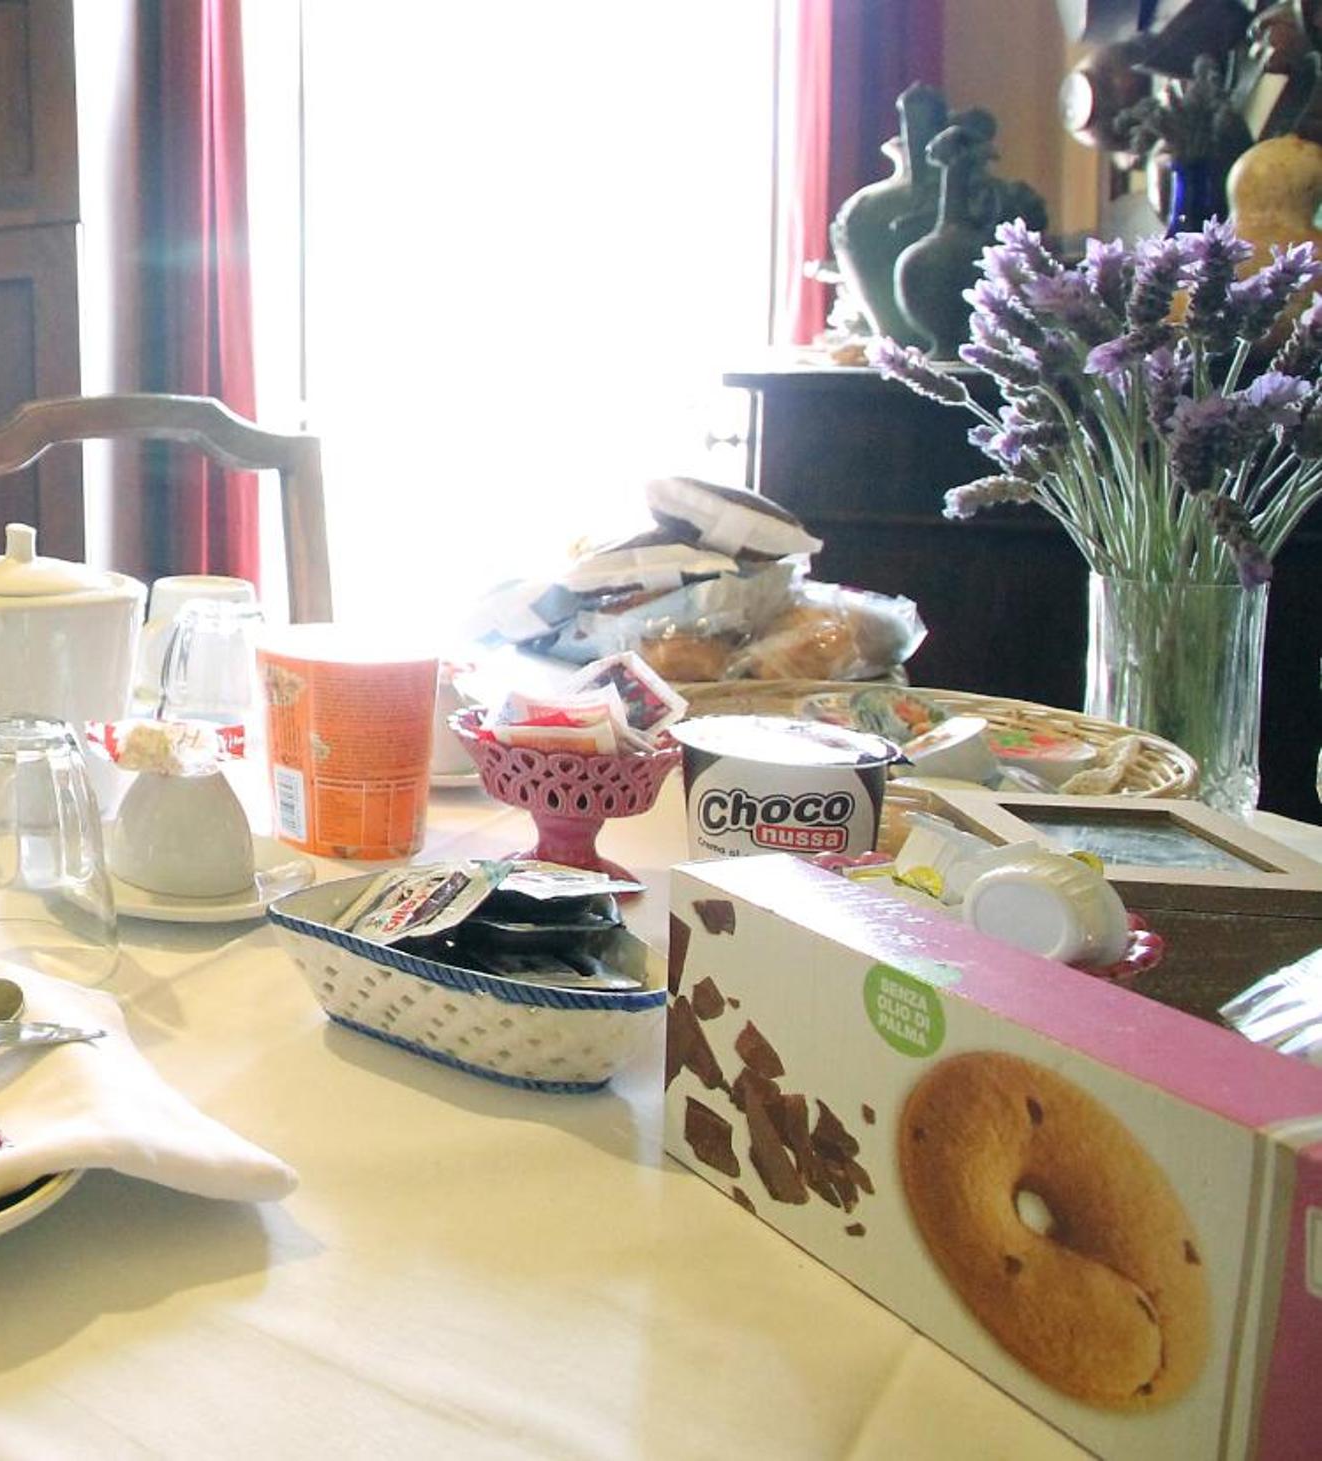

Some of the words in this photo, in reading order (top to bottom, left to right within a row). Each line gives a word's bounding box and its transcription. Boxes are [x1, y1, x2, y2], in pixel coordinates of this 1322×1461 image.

[700, 791, 852, 832] Choco
[697, 836, 726, 854] Crema
[761, 826, 839, 847] nussa
[880, 977, 928, 1012] SENZA
[877, 994, 910, 1021] OLIO
[916, 1011, 930, 1033] DI
[878, 1011, 927, 1047] PALMA
